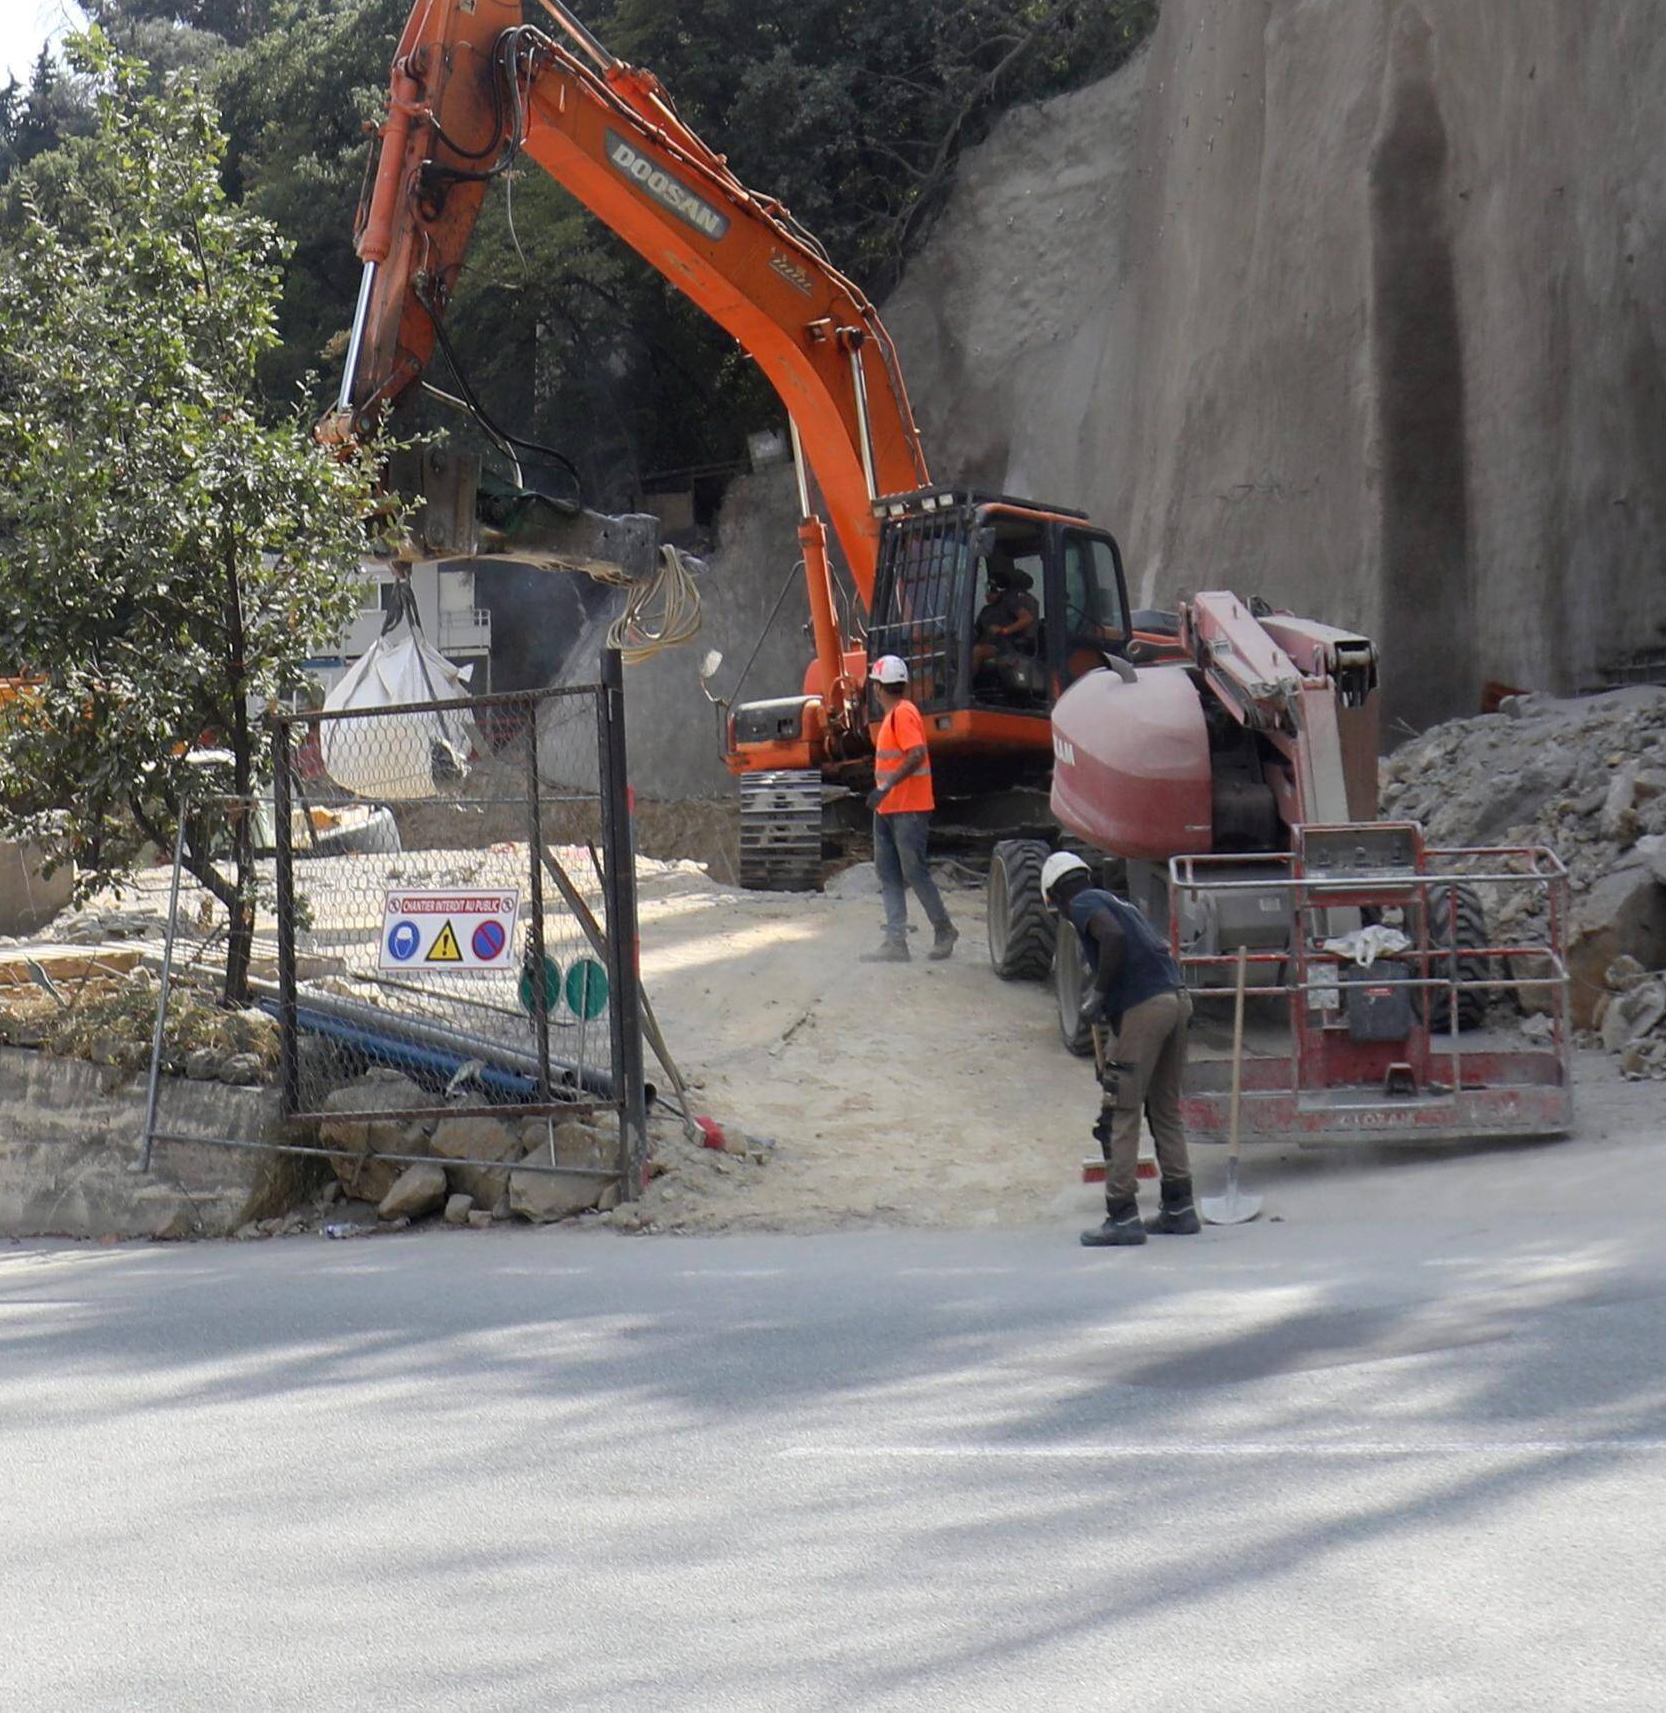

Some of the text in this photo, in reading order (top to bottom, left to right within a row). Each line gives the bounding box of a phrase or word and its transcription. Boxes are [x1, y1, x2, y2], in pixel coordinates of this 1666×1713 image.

[612, 144, 721, 233] DOOSAN
[403, 900, 499, 912] CHANTIER INTERDIT AU PUBLIC
